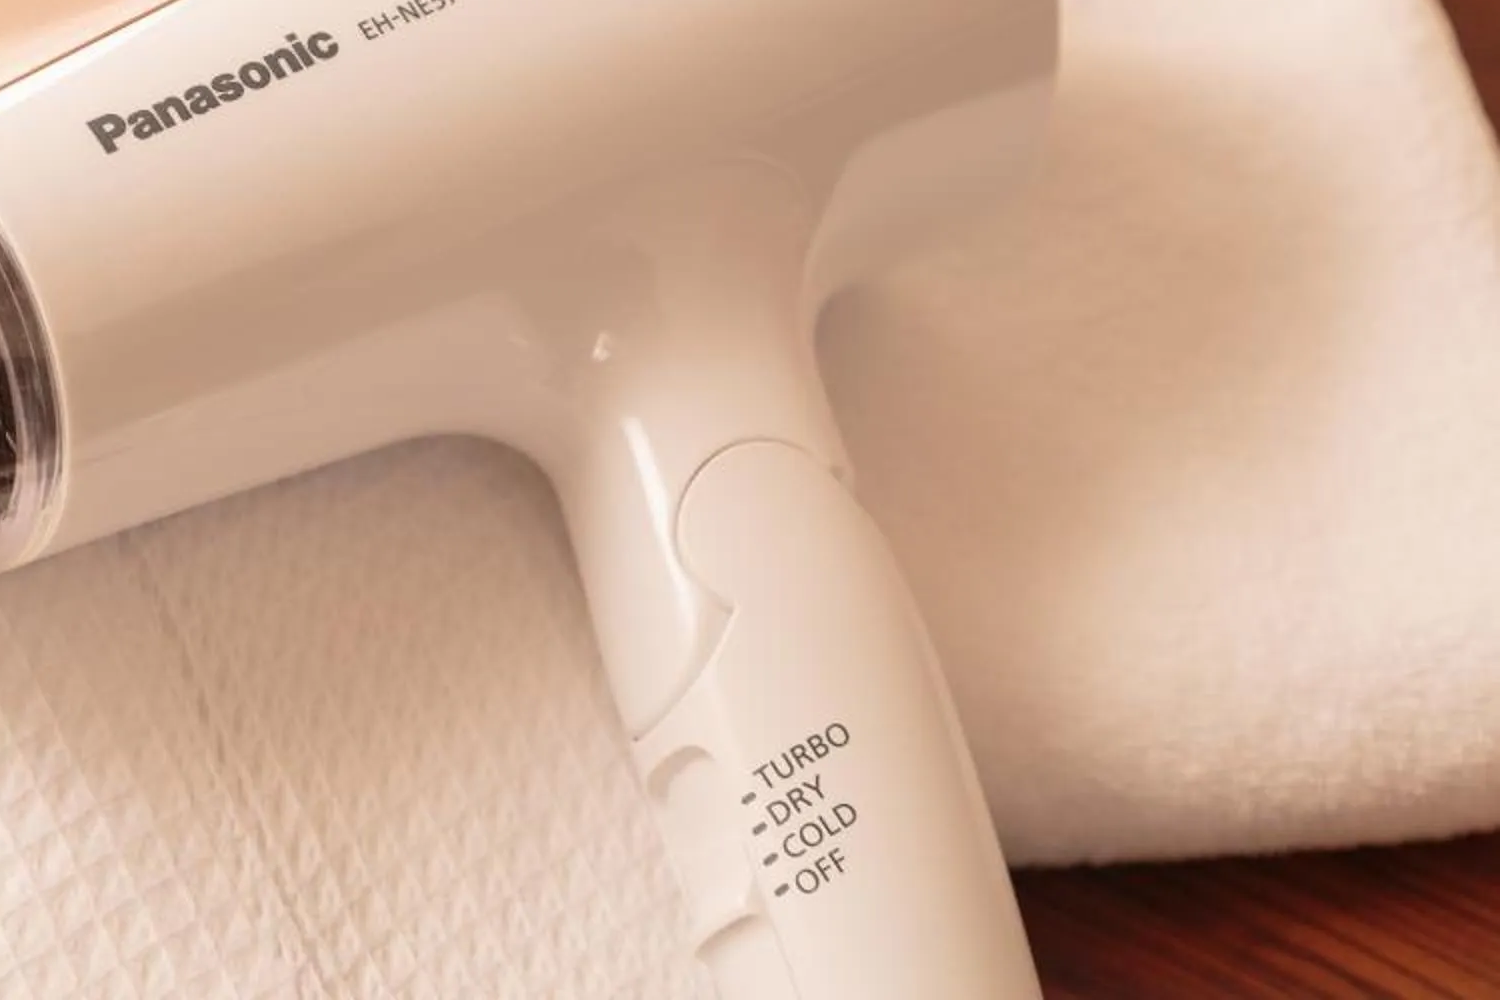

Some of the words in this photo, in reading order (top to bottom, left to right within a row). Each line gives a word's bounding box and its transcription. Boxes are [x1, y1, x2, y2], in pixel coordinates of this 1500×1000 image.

[86, 30, 339, 154] Panasonic
[752, 723, 850, 789] TURBO
[766, 774, 825, 826] DRY
[783, 803, 857, 858] COLD
[795, 848, 845, 894] OFF
